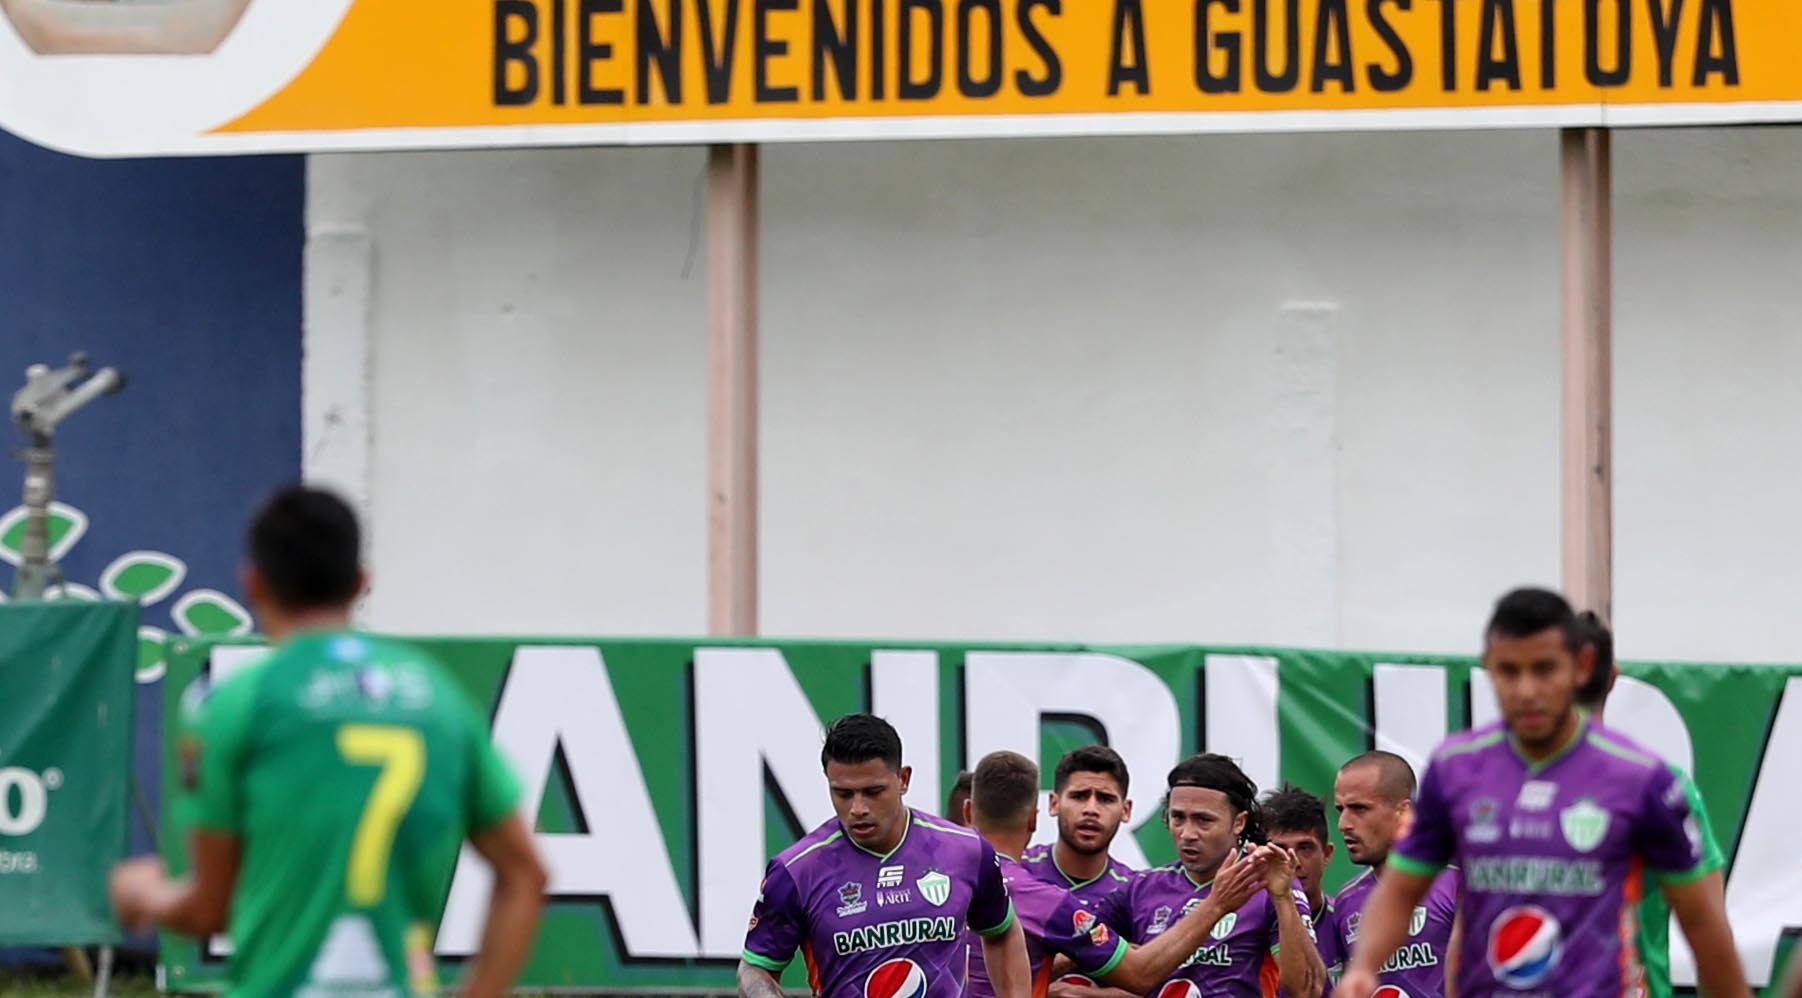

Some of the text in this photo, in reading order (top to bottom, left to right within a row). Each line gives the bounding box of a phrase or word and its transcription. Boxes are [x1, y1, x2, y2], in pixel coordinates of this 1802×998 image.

[493, 0, 1740, 106] BIENVENIDOS A GUASTATOYA
[335, 724, 426, 907] 7
[833, 916, 956, 956] BANRURAL
